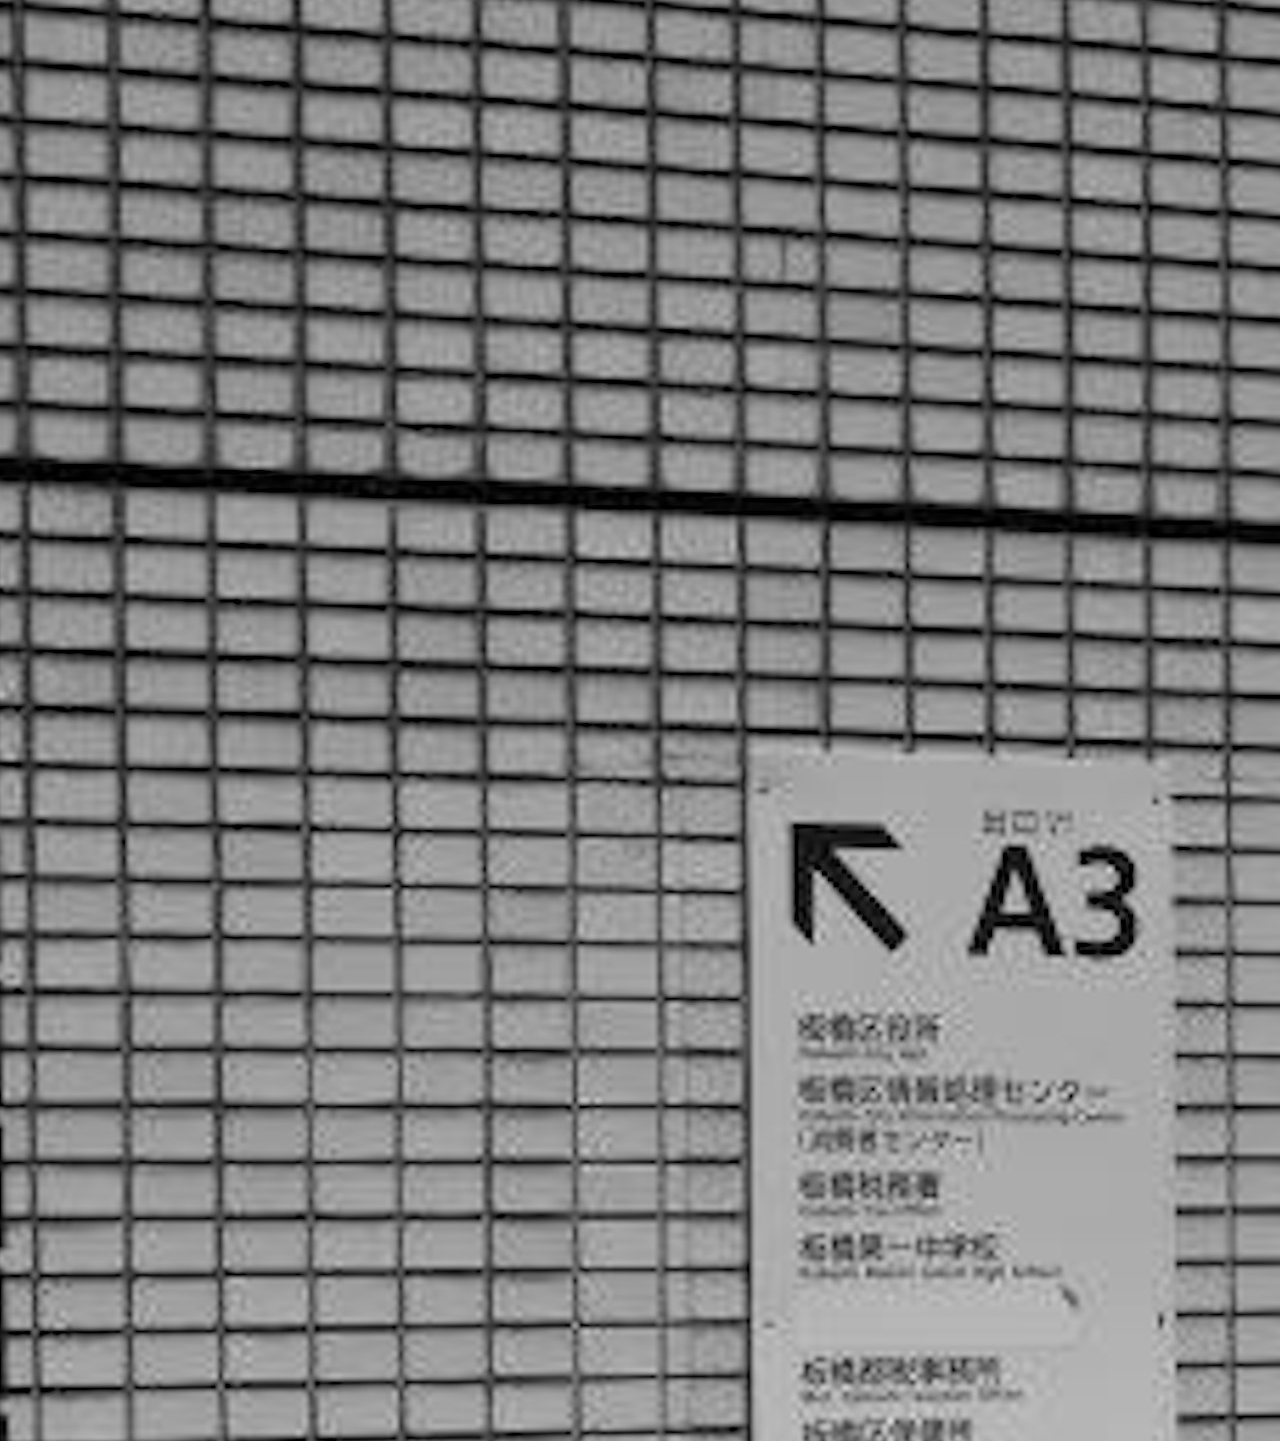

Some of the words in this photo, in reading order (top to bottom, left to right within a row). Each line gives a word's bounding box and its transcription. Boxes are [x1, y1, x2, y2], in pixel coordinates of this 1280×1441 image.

[967, 844, 1136, 958] A3
[798, 1013, 940, 1042] 板橋区役所
[798, 1171, 940, 1200] 板橋税務署
[798, 1233, 999, 1261] 板橋第一中学校
